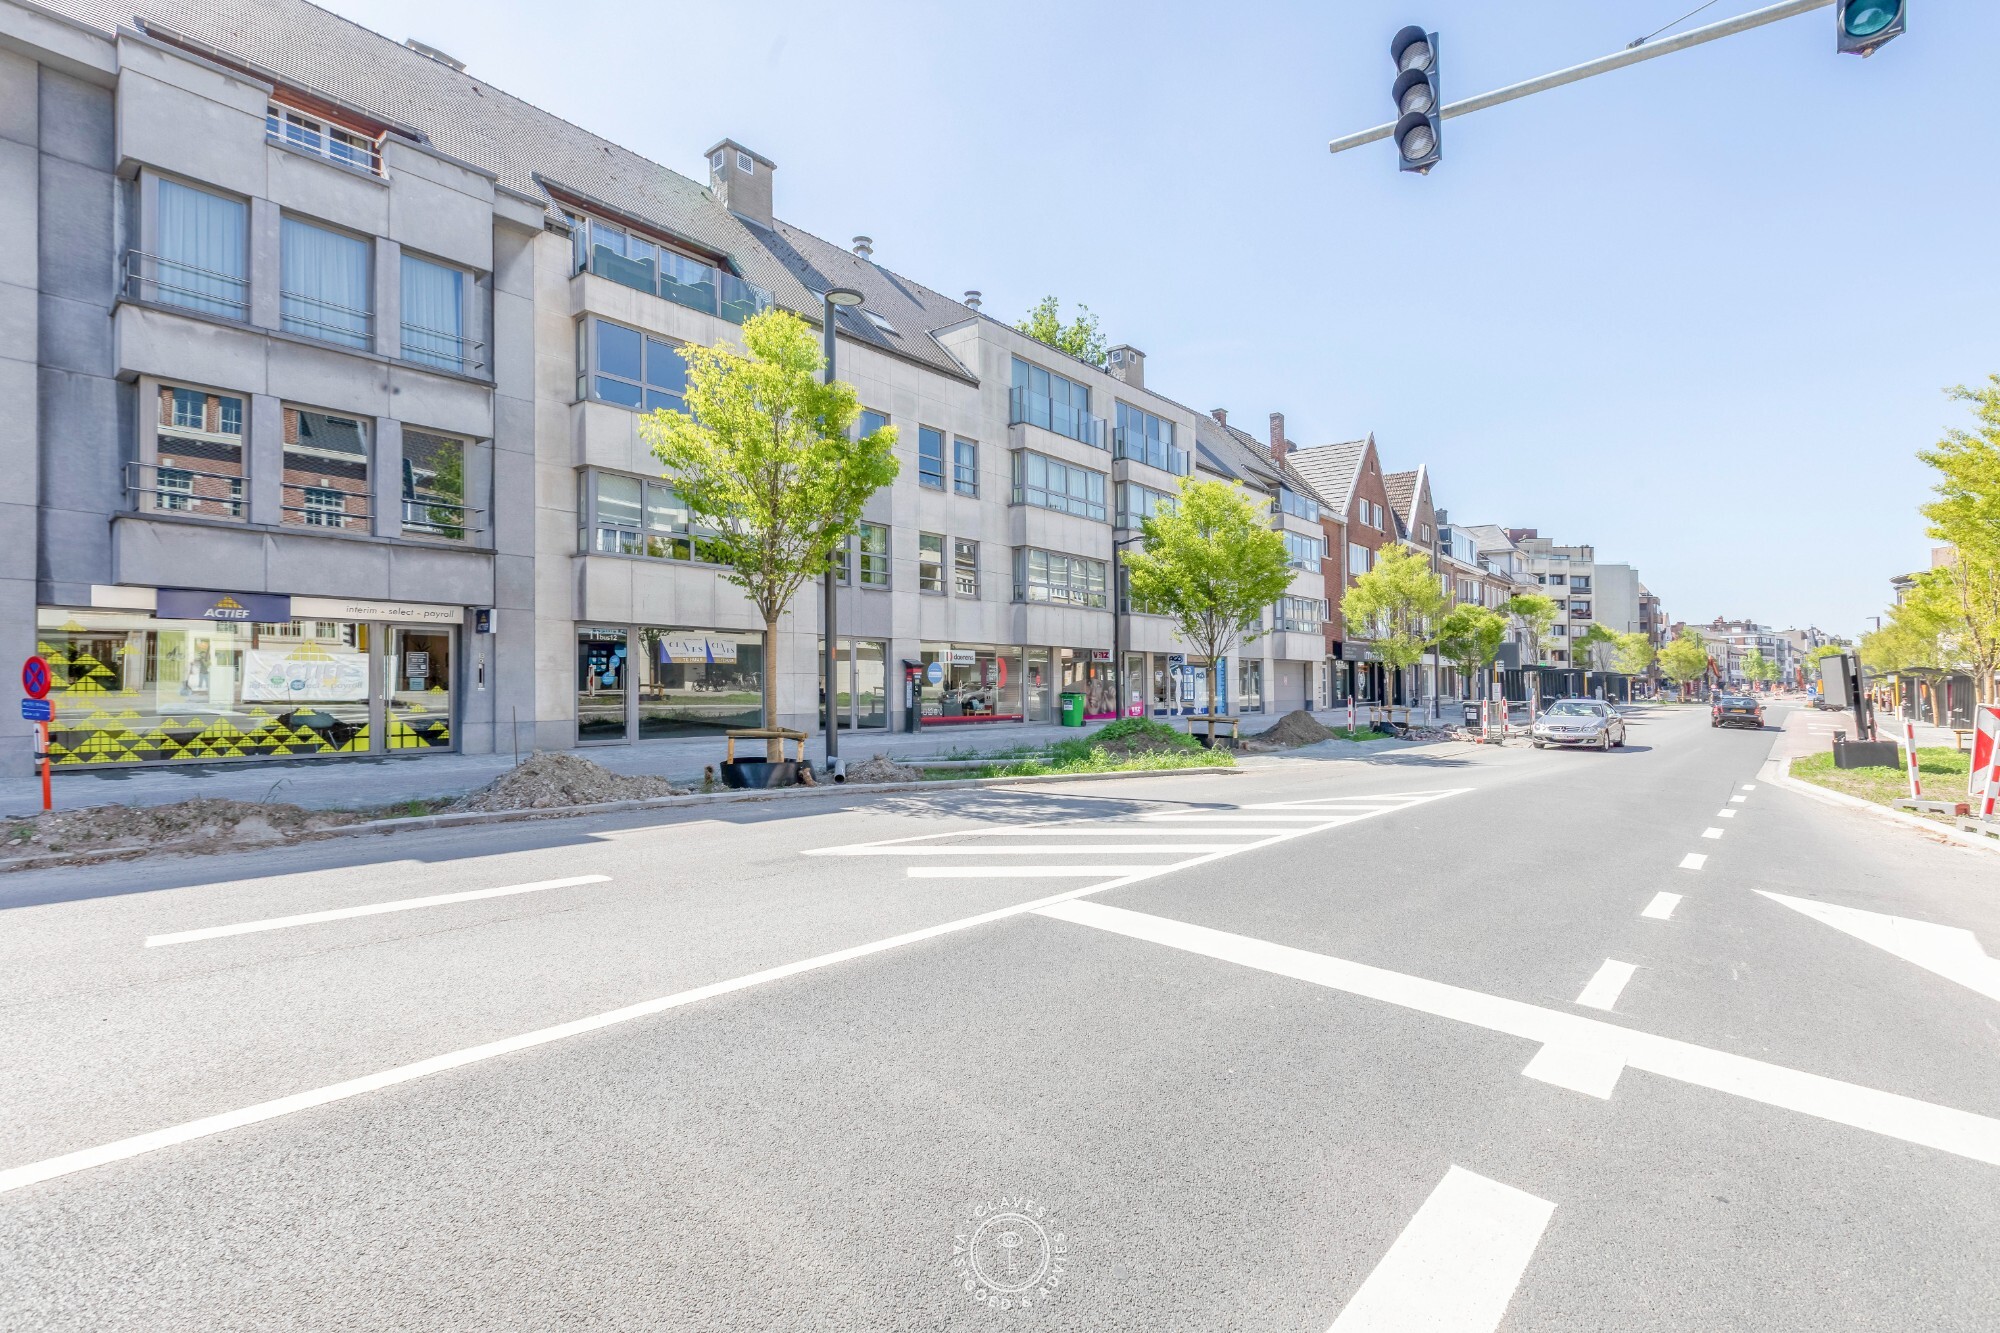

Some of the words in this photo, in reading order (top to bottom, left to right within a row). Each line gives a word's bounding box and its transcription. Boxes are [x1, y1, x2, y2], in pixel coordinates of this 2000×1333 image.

[204, 608, 250, 619] ACTIEF
[345, 605, 378, 614] interim
[388, 607, 414, 616] select
[423, 609, 454, 619] payroll
